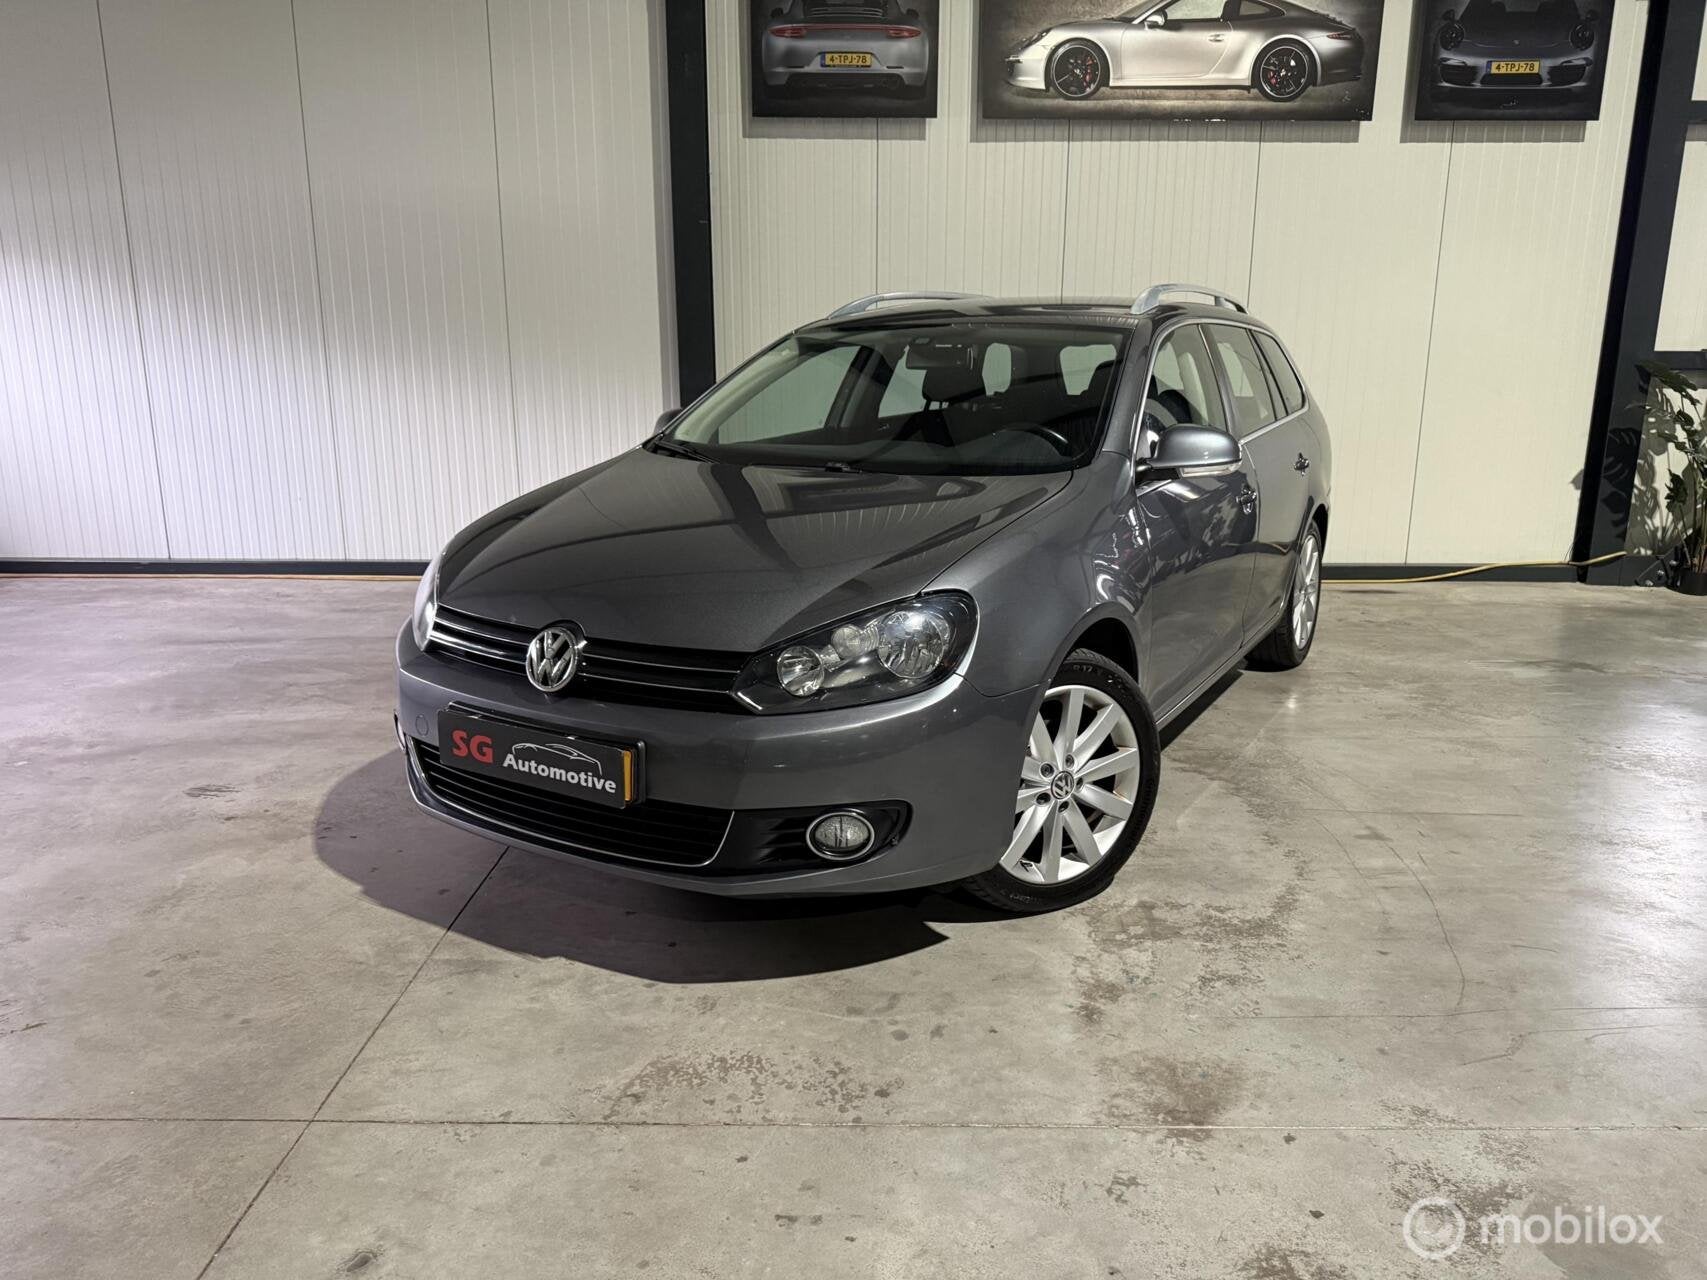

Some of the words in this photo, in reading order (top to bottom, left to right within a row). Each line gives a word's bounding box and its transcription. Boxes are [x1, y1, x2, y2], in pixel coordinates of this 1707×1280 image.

[829, 55, 867, 64] 4-TPJ-78
[1495, 62, 1535, 73] 4-TPJ-78
[451, 729, 494, 763] SG
[502, 753, 616, 793] Automotive
